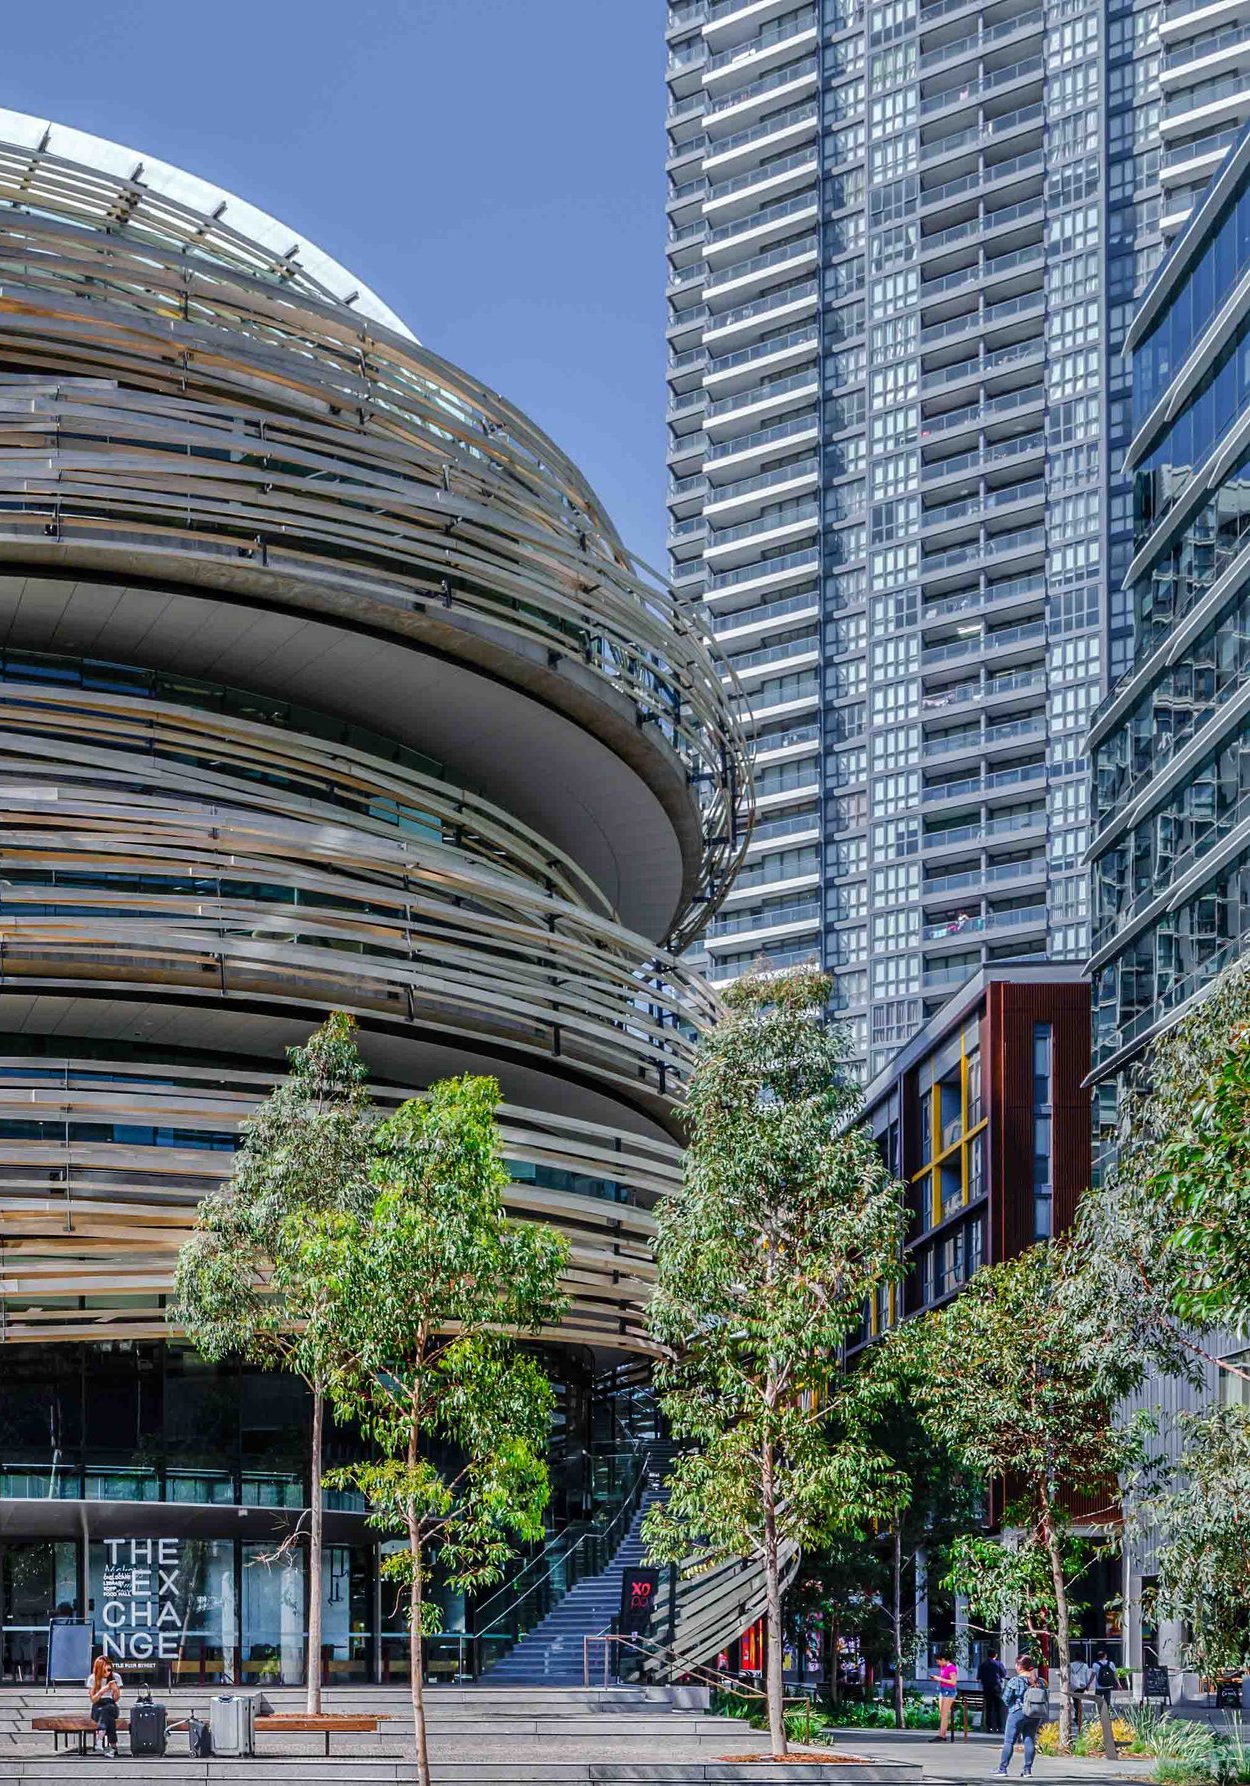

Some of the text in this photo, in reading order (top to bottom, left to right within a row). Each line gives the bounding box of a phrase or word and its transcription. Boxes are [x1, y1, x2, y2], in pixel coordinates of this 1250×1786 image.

[103, 1538, 179, 1565] THE
[132, 1569, 180, 1596] EX
[632, 1582, 651, 1597] XO
[102, 1601, 182, 1627] CHA
[102, 1632, 179, 1659] NGE
